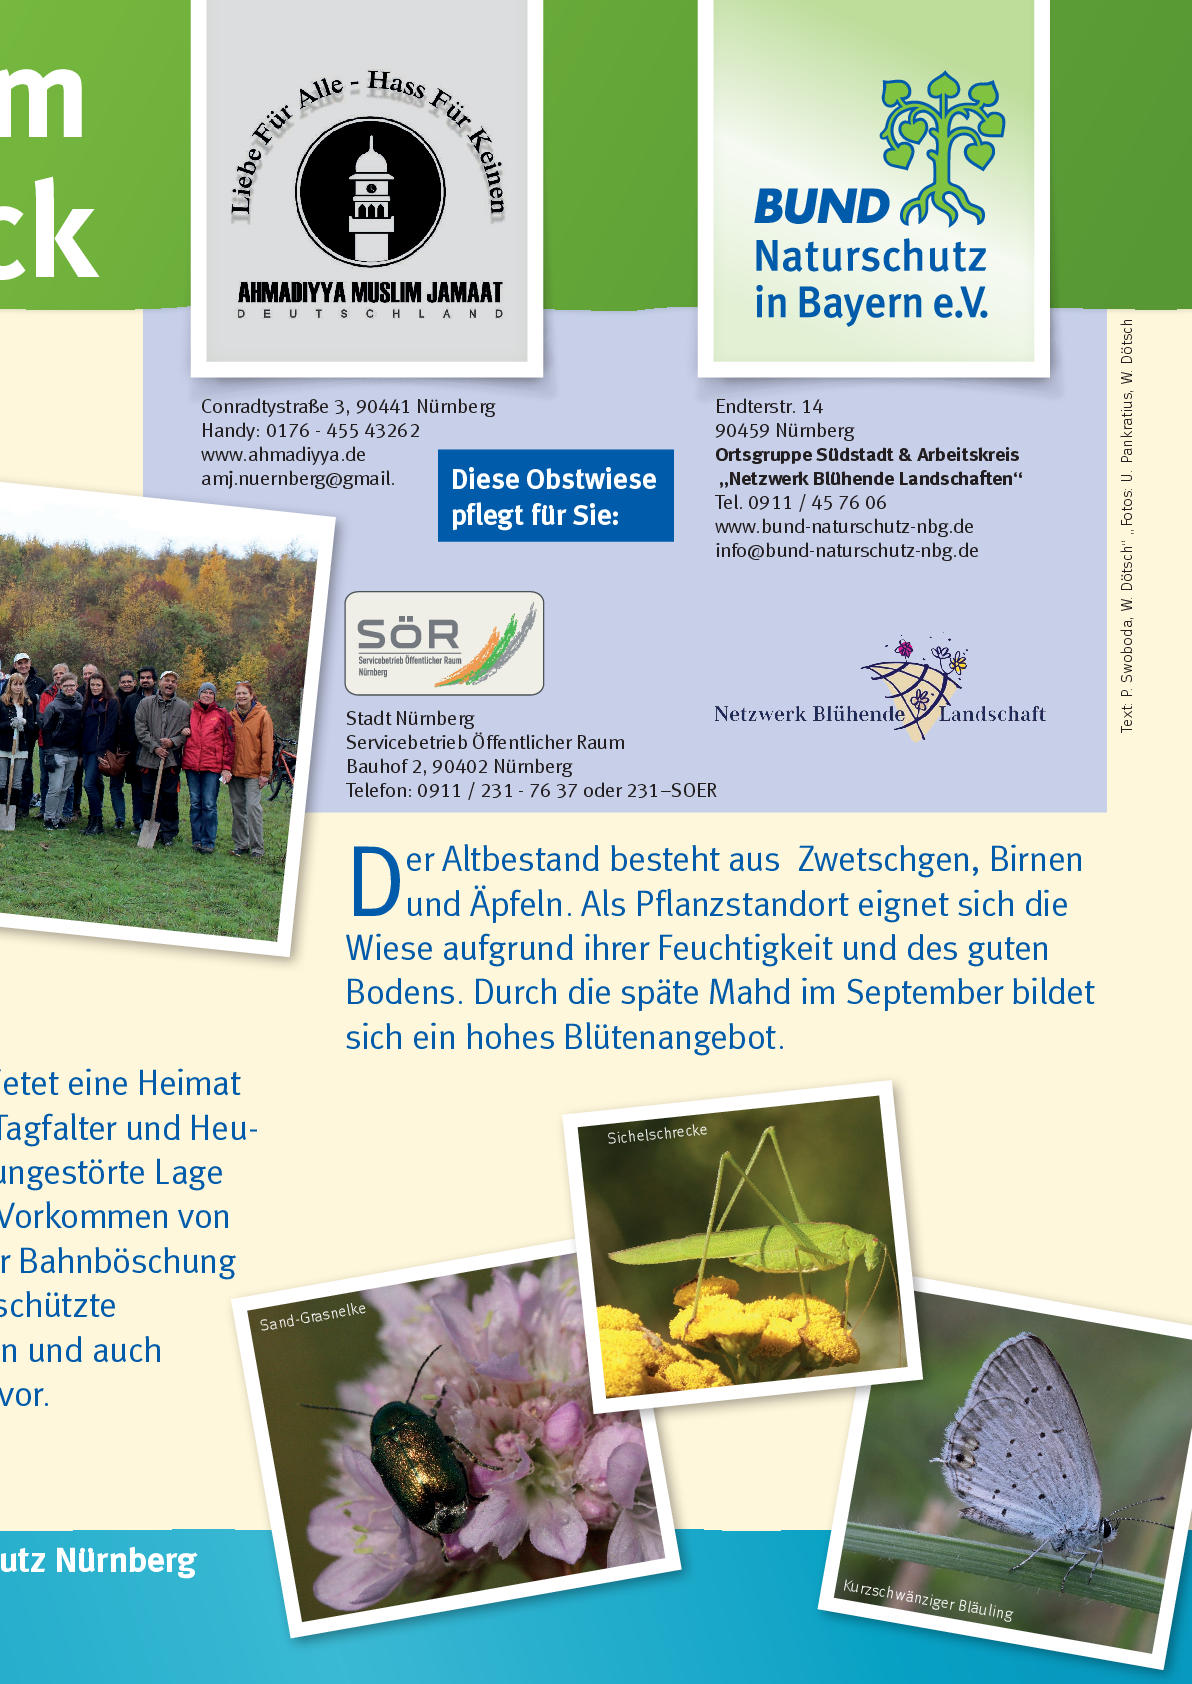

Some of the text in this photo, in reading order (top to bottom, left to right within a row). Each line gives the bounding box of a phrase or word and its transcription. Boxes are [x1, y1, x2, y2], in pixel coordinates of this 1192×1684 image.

[231, 148, 261, 214] Liebe
[252, 104, 293, 145] Für
[299, 78, 343, 109] Alle
[368, 70, 426, 99] Hass
[429, 88, 471, 127] Für
[467, 126, 505, 214] Keinen
[754, 188, 890, 224] BUND
[755, 237, 987, 273] Naturschutz
[237, 281, 503, 304] AHMADIYYA MUSLIM JAMAAT
[755, 284, 989, 328] in Bayern e.V.
[1119, 319, 1133, 364] Dötsch
[1120, 370, 1133, 385] W.
[201, 397, 496, 418] Conradtystraße 3, 90441 Nürnberg
[716, 397, 824, 415] Endterstr. 14
[202, 421, 260, 442] Handy:
[266, 422, 310, 438] 0176
[326, 422, 359, 439] 455
[364, 422, 420, 439] 43262
[715, 422, 855, 442] 90459 Nürnberg
[1119, 390, 1135, 463] Pankratius,
[200, 445, 366, 466] www.ahmadiyya.de
[715, 446, 1020, 465] Ortsgruppe Südstadt & Arbeitskreis
[201, 469, 395, 490] amj.nuernberg@gmail.
[452, 466, 657, 490] Diese Obstwiese
[813, 470, 895, 486] Blühende
[1120, 470, 1133, 482] U.
[714, 493, 743, 510] Tel.
[748, 495, 792, 511] 0911
[811, 494, 833, 511] 45
[838, 494, 860, 510] 76
[865, 494, 887, 510] 06
[452, 501, 619, 531] pflegt für Sie:
[714, 517, 974, 538] www.bund-naturschutz-nbg.de
[716, 541, 979, 562] info@bund-naturschutz-nbg.de
[1120, 597, 1133, 612] W.
[358, 654, 462, 665] Servicebetrieb Öffentlicher Raum
[1119, 617, 1135, 684] Swoboda,
[358, 667, 388, 678] Nürnberg
[1120, 688, 1133, 697] P.
[346, 709, 475, 730] Stadt Nürnberg
[714, 705, 1047, 721] Netzwerk Blühende Landschaft
[1120, 703, 1133, 734] Text:
[346, 731, 625, 750] Servicebetrieb Öffentlicher Raum
[347, 758, 573, 778] Bauhof 2, 90402 Nürnberg
[345, 781, 412, 798] Telefon:
[417, 783, 461, 799] 0911
[481, 783, 513, 799] 231
[529, 782, 551, 798] 76
[556, 783, 578, 799] 37
[583, 781, 623, 798] oder
[346, 1021, 784, 1057] sich ein hohes Blütenangebot.
[607, 1124, 708, 1145] Sichelschrecke
[20, 1246, 237, 1281] Bahnböschung
[259, 1302, 366, 1331] Sand-Grasnelke
[29, 1335, 82, 1363] und
[93, 1335, 161, 1363] auch
[56, 1546, 198, 1579] Nürnberg
[843, 1579, 1014, 1623] Kurzschwänziger Bläuling
